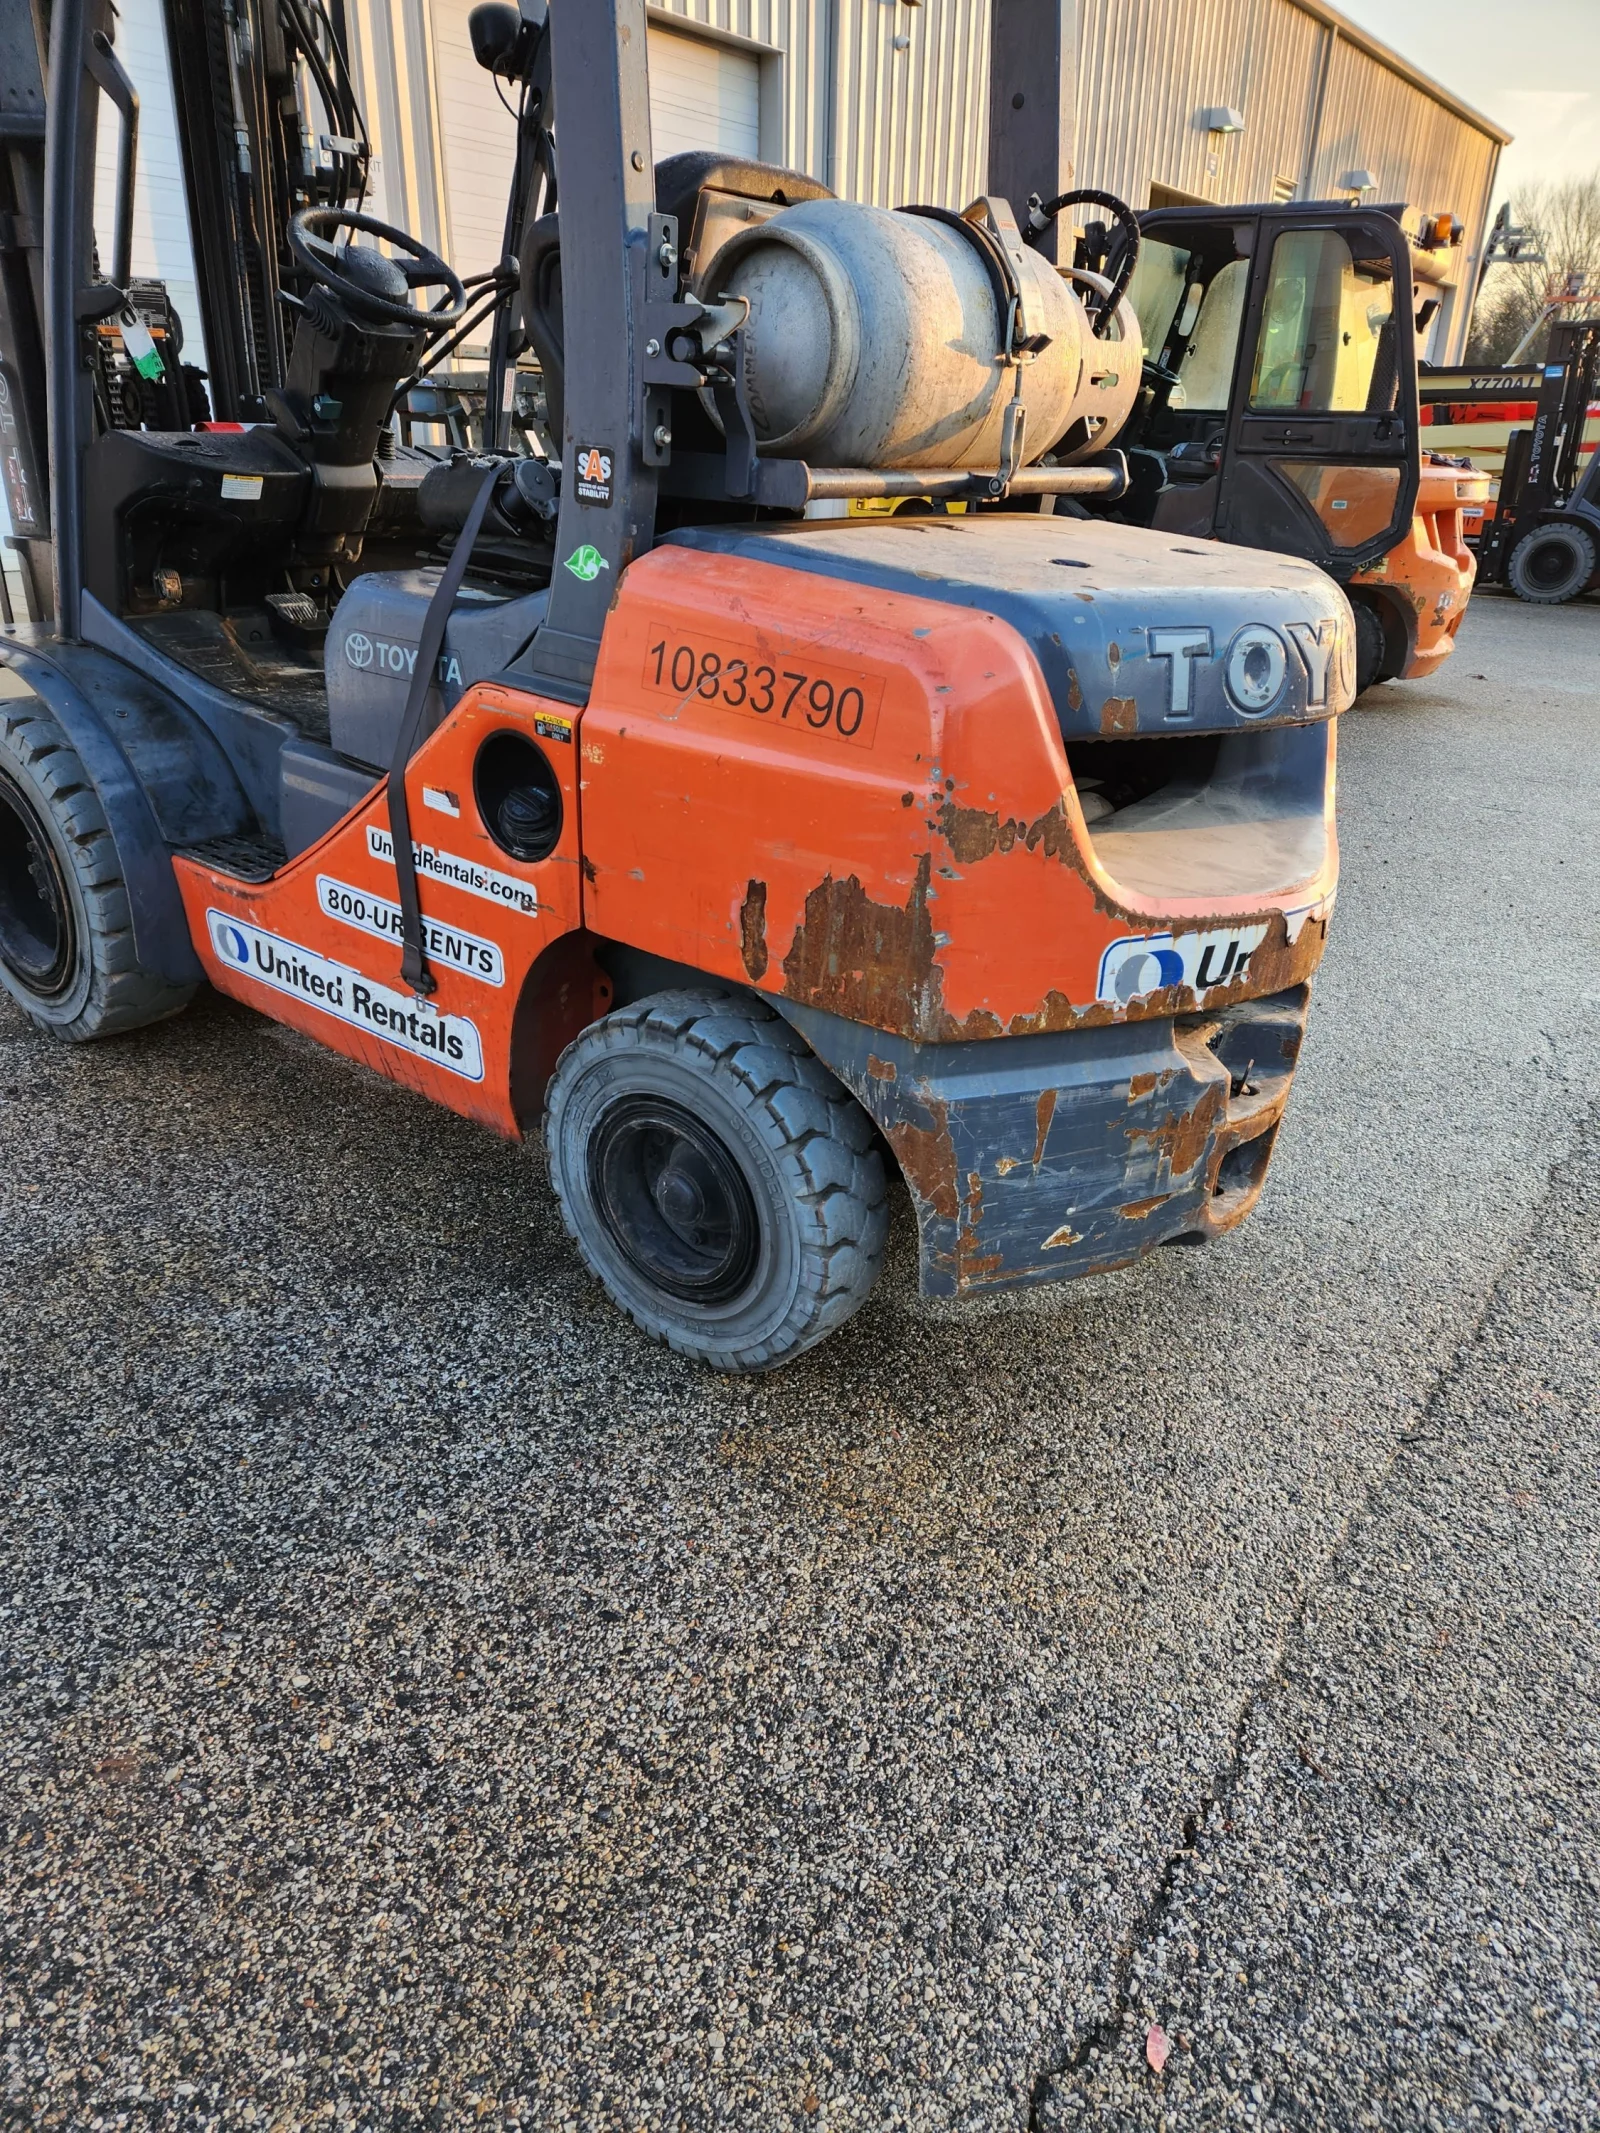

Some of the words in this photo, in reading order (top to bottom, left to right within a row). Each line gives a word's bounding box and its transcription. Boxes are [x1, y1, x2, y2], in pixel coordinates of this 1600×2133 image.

[577, 449, 612, 483] SAS
[1531, 414, 1547, 461] TOYOTA
[578, 488, 609, 500] STABILITY
[376, 642, 463, 686] TOYTA
[651, 640, 864, 736] 10833790
[371, 833, 533, 907] UndRentals.com
[328, 888, 494, 973] 800-URRENTS
[254, 940, 343, 1007] United
[352, 983, 464, 1060] Rentals
[730, 1114, 789, 1226] SOLIDEAL
[649, 1301, 717, 1336] 6.50-10
